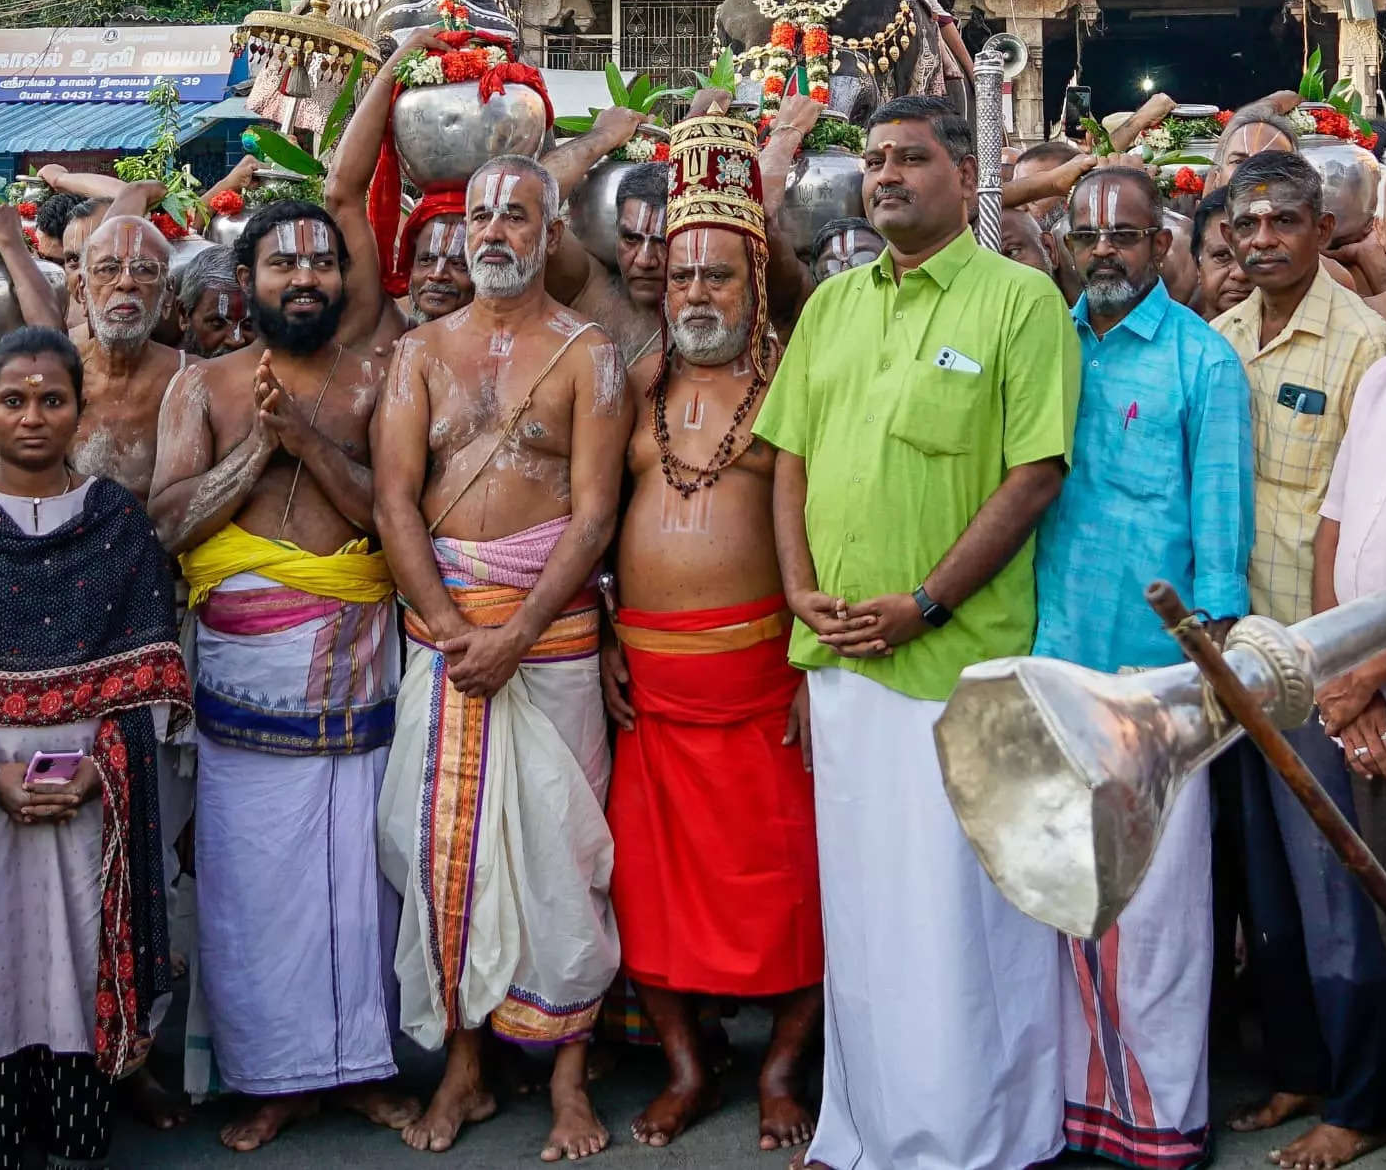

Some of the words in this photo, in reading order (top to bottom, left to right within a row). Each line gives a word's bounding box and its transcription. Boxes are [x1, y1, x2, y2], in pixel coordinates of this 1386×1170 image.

[69, 45, 135, 73] உதவி
[141, 45, 221, 69] மையம்
[0, 76, 57, 89] ஸ்ரீரங்கம்
[59, 76, 97, 88] காவல்
[99, 76, 150, 89] நிலையம்
[181, 76, 201, 86] 39
[19, 90, 53, 101] போன்
[62, 90, 92, 101] 0431
[103, 90, 114, 100] 2
[115, 90, 132, 100] 43
